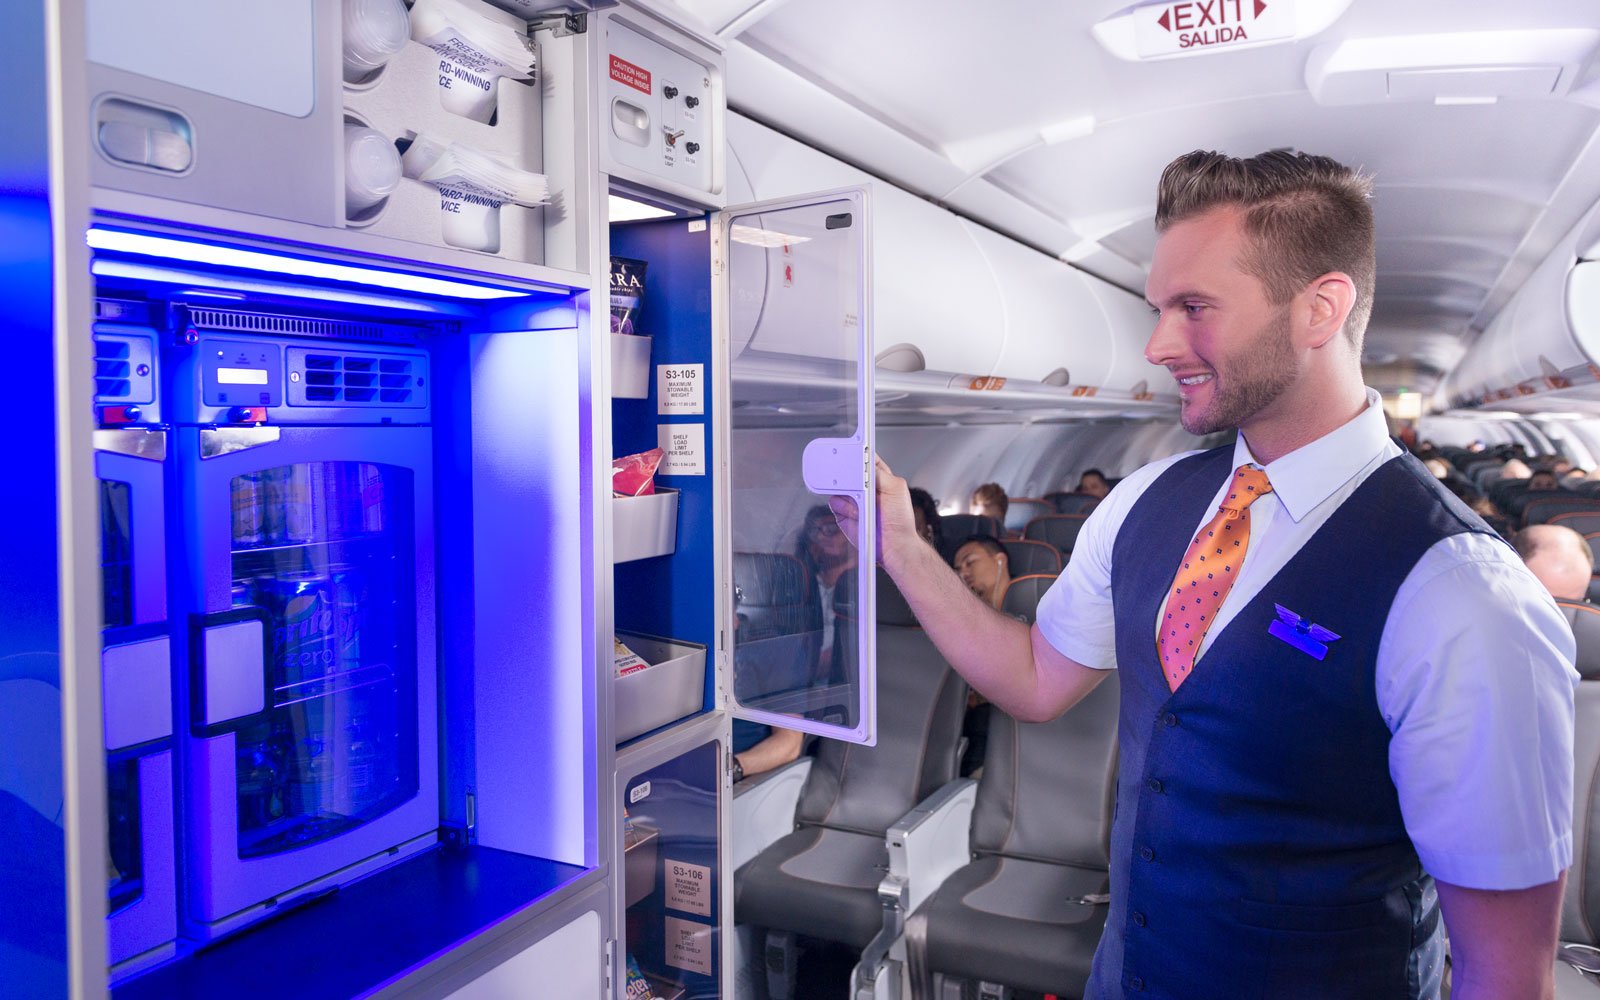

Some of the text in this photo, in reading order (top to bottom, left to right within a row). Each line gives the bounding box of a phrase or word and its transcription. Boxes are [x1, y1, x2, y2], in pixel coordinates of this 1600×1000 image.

[1174, 0, 1241, 30] EXIT
[448, 38, 475, 53] FREE
[1179, 26, 1247, 48] SALIDA
[611, 68, 650, 91] VOLTAGE INSIDE
[614, 60, 648, 81] CAUTION HIGH
[439, 74, 452, 90] CE.
[666, 370, 695, 379] S3-105
[284, 649, 333, 667] zero
[673, 866, 702, 880] S3-106
